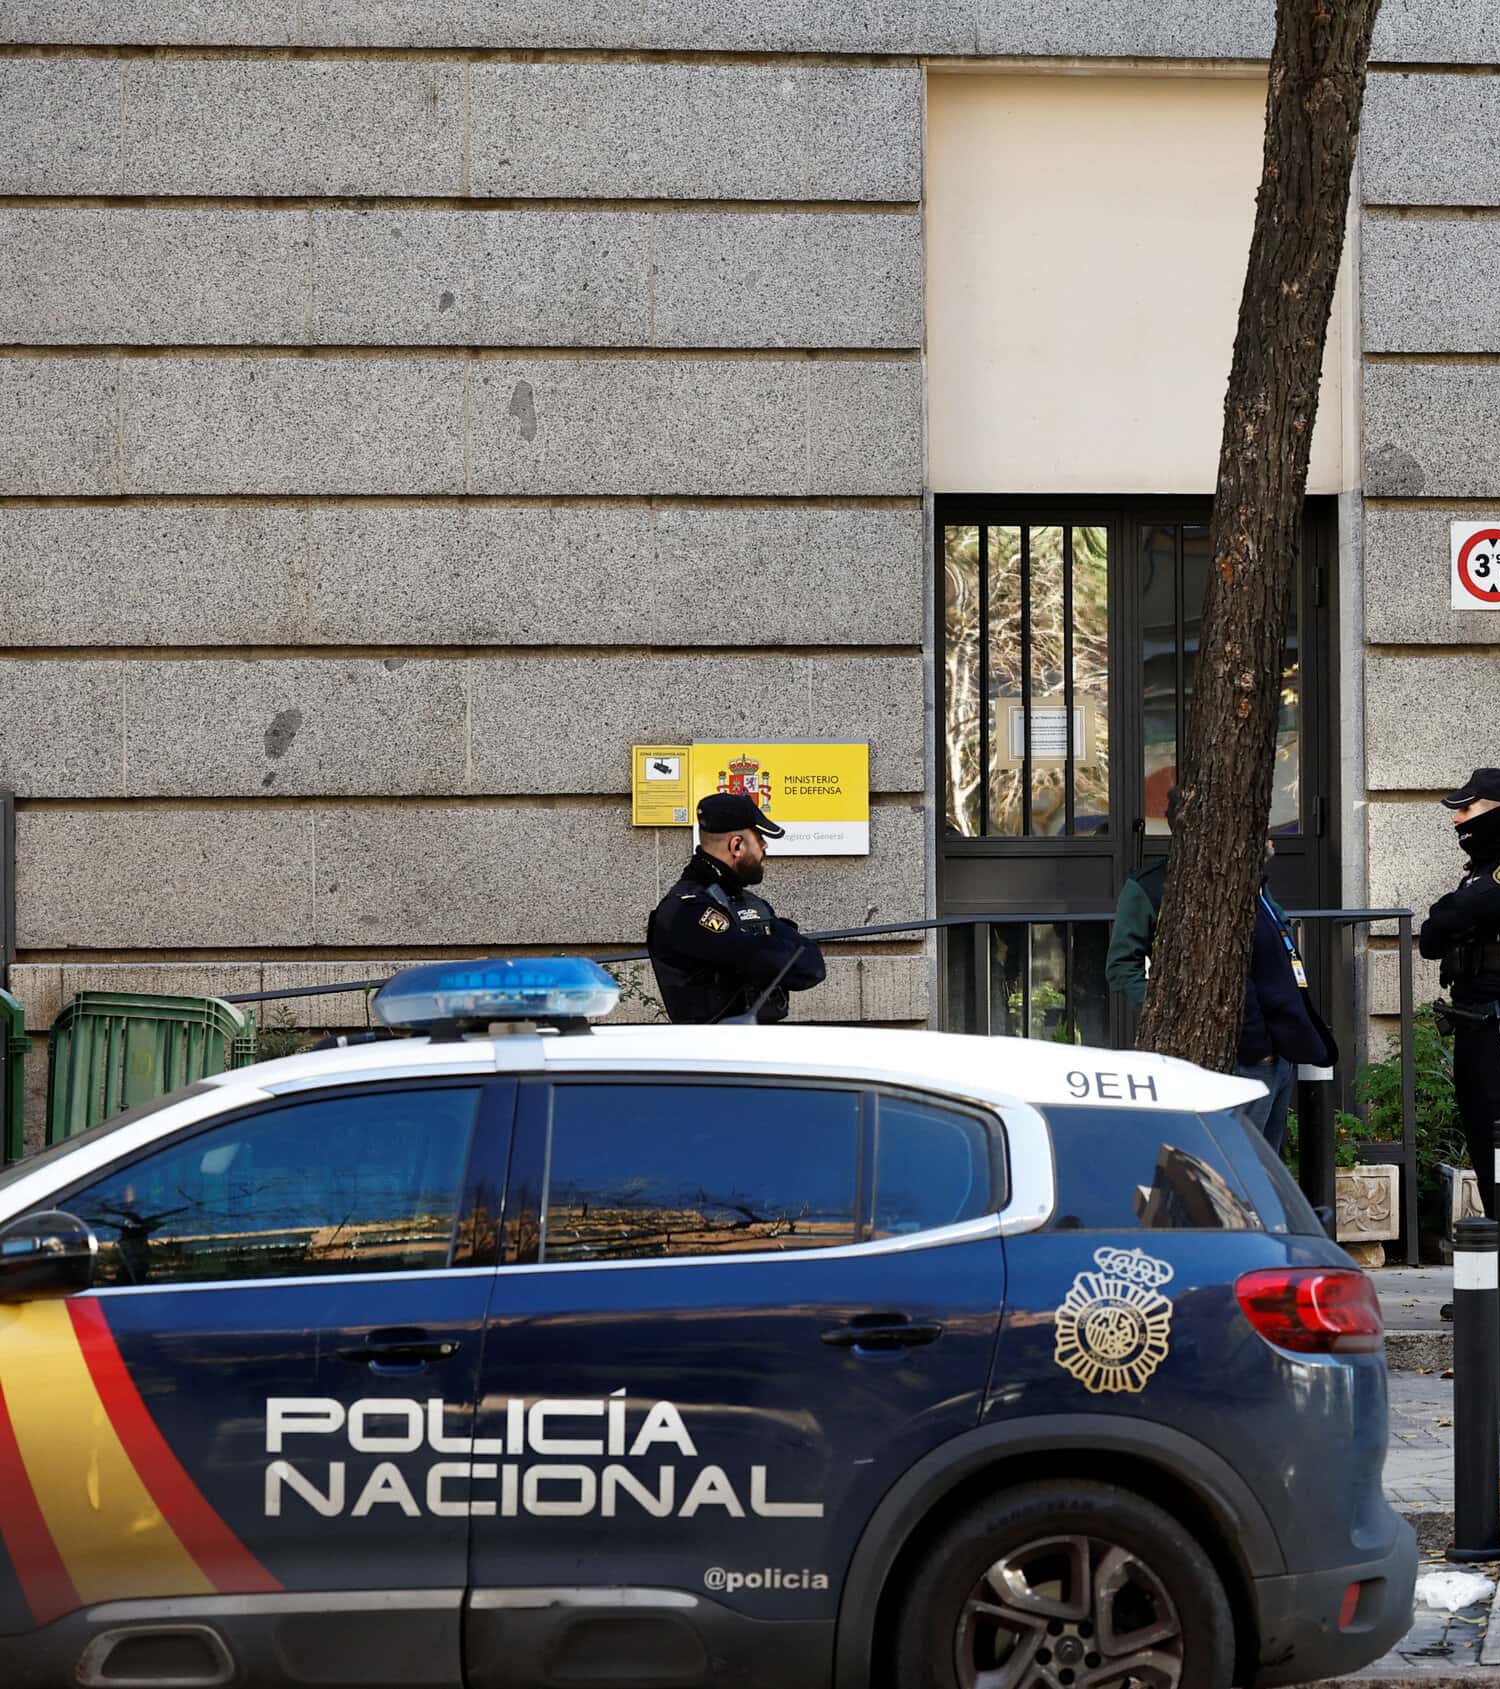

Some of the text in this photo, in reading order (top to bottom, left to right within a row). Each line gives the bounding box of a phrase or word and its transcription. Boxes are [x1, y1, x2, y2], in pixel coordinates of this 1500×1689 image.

[784, 775, 839, 784] MINISTERIO
[784, 786, 842, 795] DE DEFENSA
[784, 832, 811, 842] egistro
[1066, 1070, 1158, 1102] 9EH
[266, 1387, 698, 1456] POLICÍA
[264, 1460, 825, 1518] NACIONAL
[703, 1567, 829, 1592] @policia
